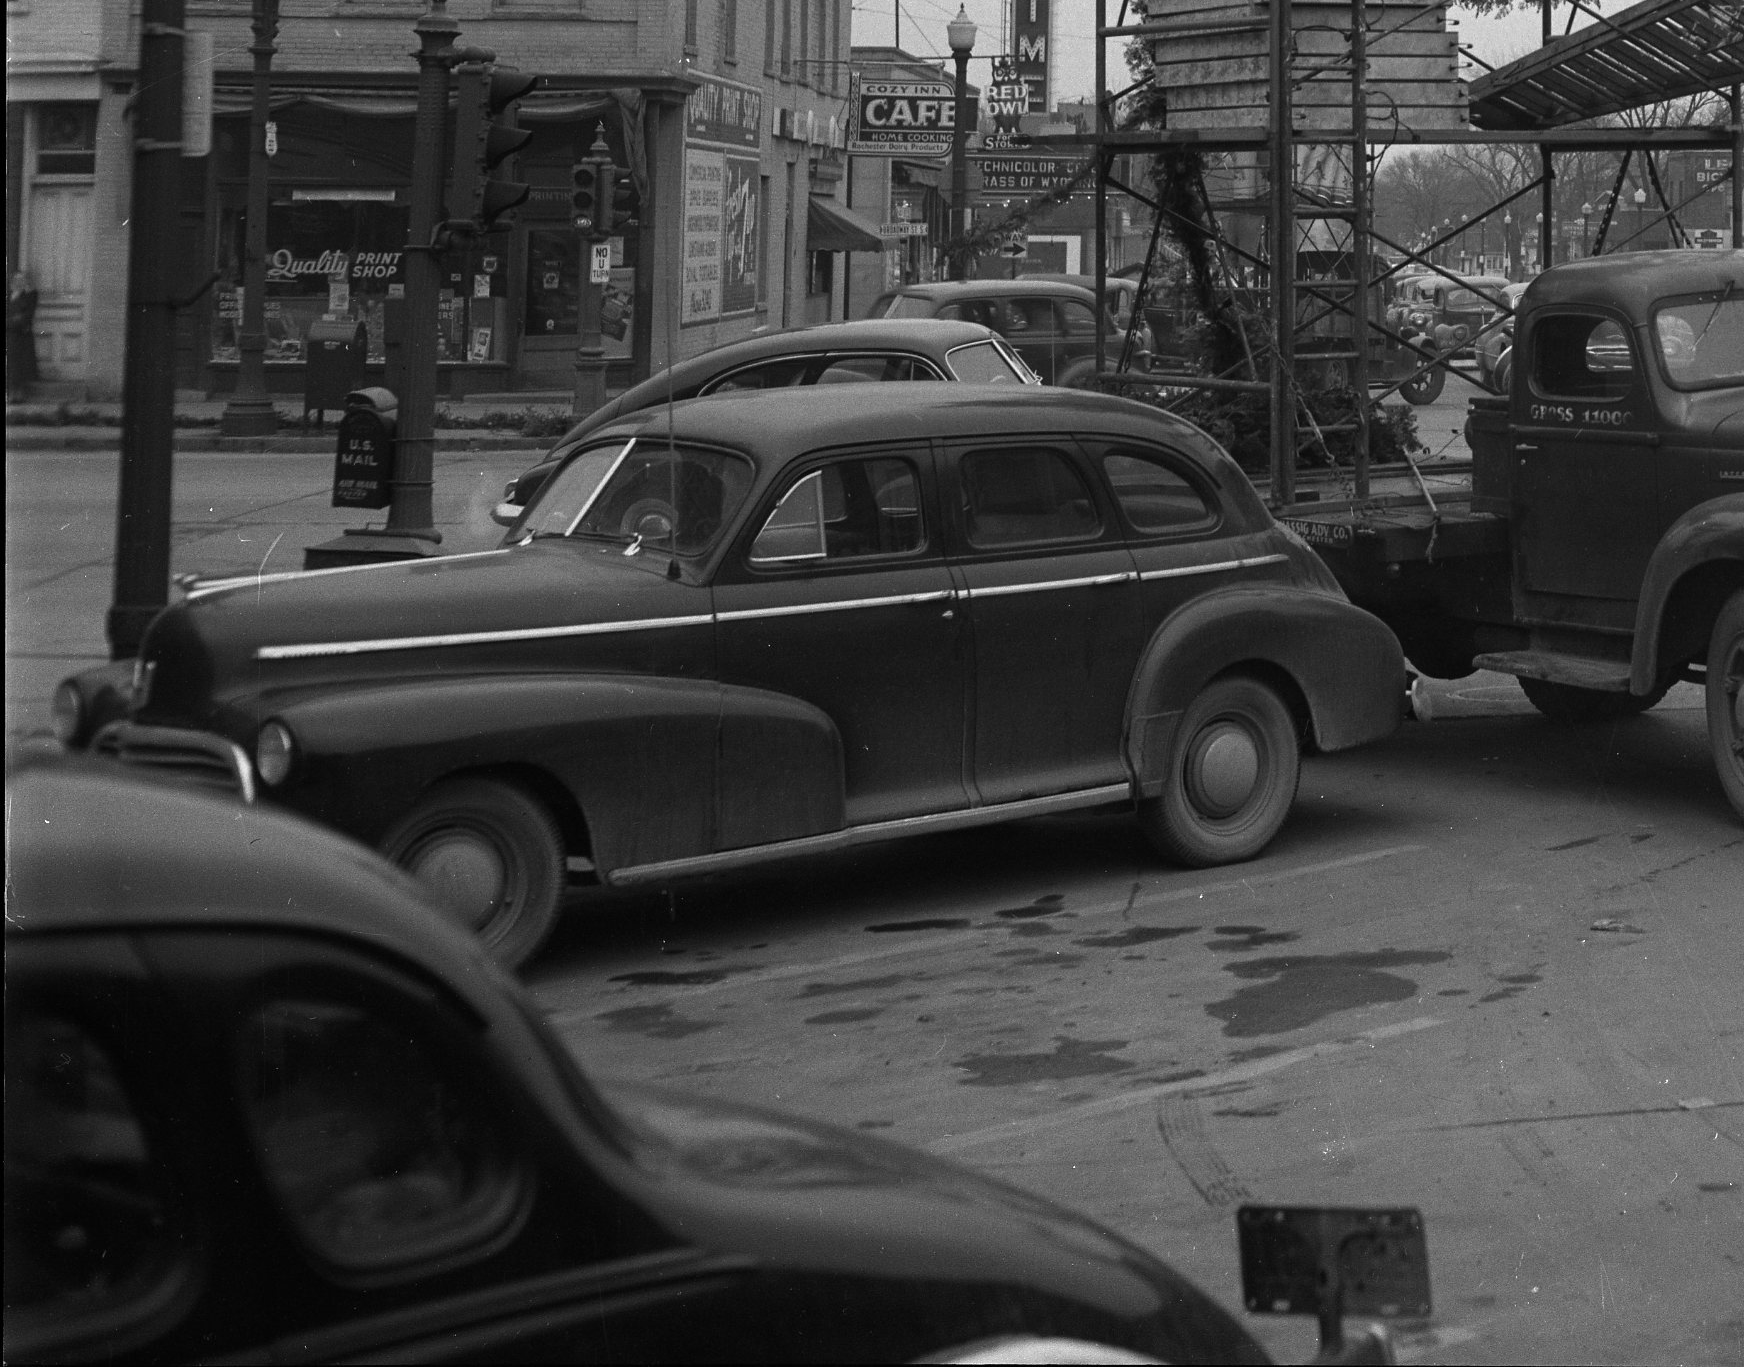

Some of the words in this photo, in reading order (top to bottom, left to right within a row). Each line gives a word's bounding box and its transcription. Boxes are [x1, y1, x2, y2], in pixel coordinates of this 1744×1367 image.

[866, 85, 909, 94] COZY
[914, 86, 941, 95] INN
[987, 85, 1027, 99] RED
[742, 91, 760, 131] SHOP
[865, 98, 956, 128] CAFE
[987, 100, 1027, 116] OWL
[872, 133, 904, 142] HOME
[907, 134, 954, 143] COOKING
[852, 142, 887, 150] Rochester
[889, 143, 908, 152] Dairy
[911, 143, 944, 151] Products
[976, 161, 1056, 173] ECHNICOLOR
[1020, 176, 1035, 187] OF
[528, 190, 573, 201] PRINTIN
[595, 247, 609, 259] NO
[267, 249, 349, 280] Quality
[355, 252, 403, 265] PRINT
[598, 259, 606, 270] U
[352, 265, 398, 278] SHOP
[592, 270, 610, 280] TURN
[1530, 404, 1575, 423] GROSS
[349, 438, 375, 451] U.S.
[341, 453, 379, 466] MAIL
[1333, 526, 1349, 540] CO.
